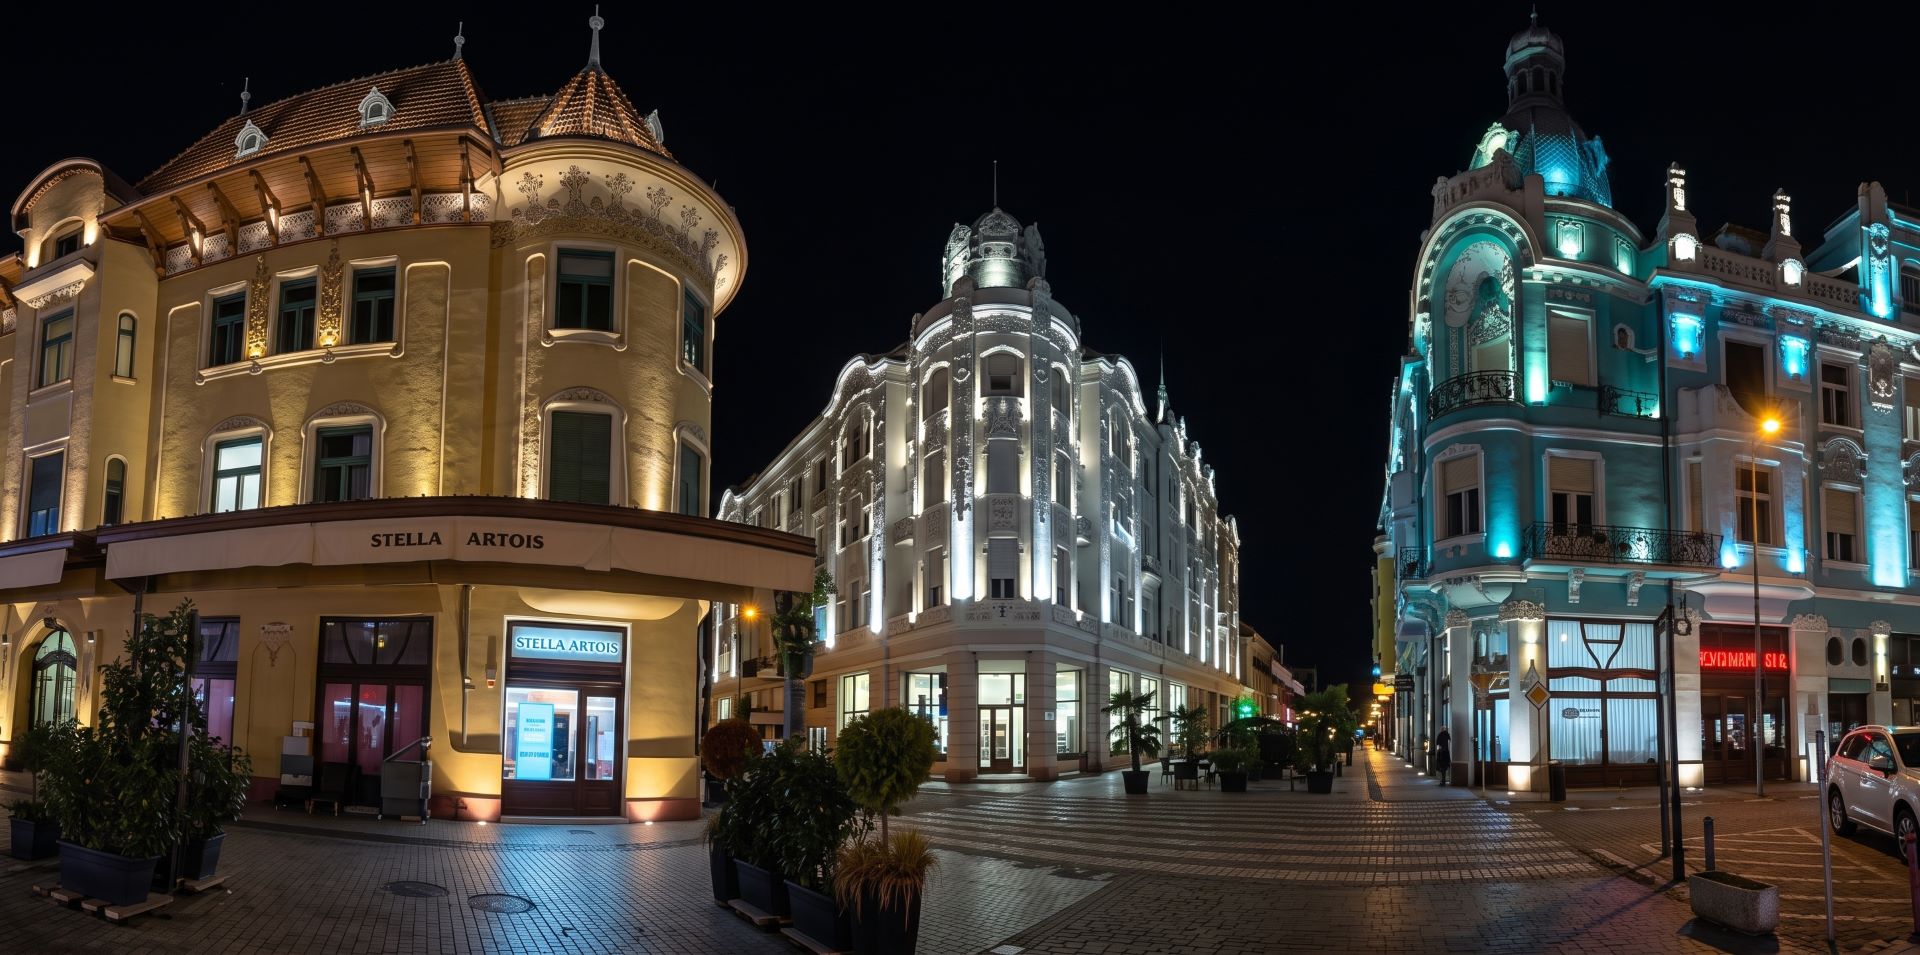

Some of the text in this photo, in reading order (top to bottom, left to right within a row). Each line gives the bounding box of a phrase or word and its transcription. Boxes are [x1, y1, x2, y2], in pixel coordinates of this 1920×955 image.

[371, 532, 545, 549] STELLA ARTOIS
[516, 636, 619, 654] STELLA ARTOIS
